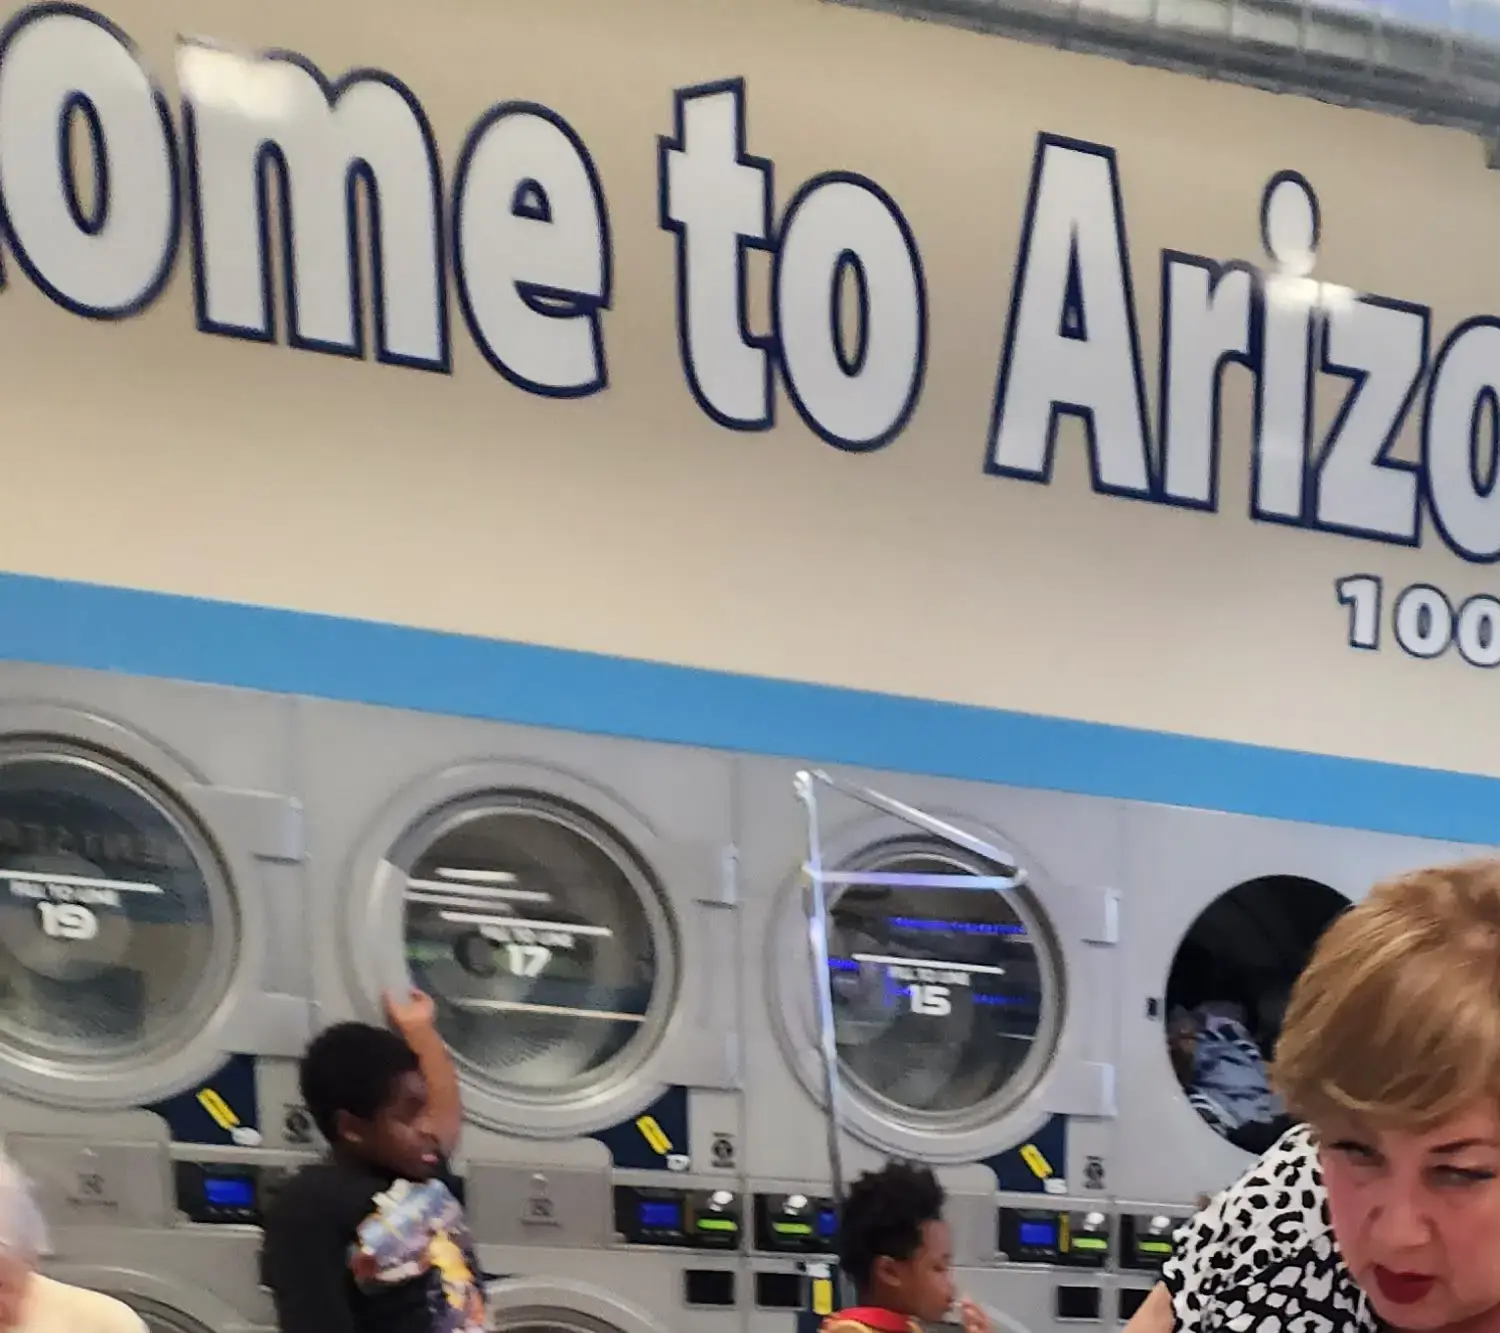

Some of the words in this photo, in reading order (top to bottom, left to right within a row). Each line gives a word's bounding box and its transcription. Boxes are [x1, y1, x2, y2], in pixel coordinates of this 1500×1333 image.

[0, 2, 612, 398] ome
[656, 76, 926, 451] to
[37, 900, 98, 940] 19
[506, 943, 552, 977] 17
[909, 983, 952, 1016] 15
